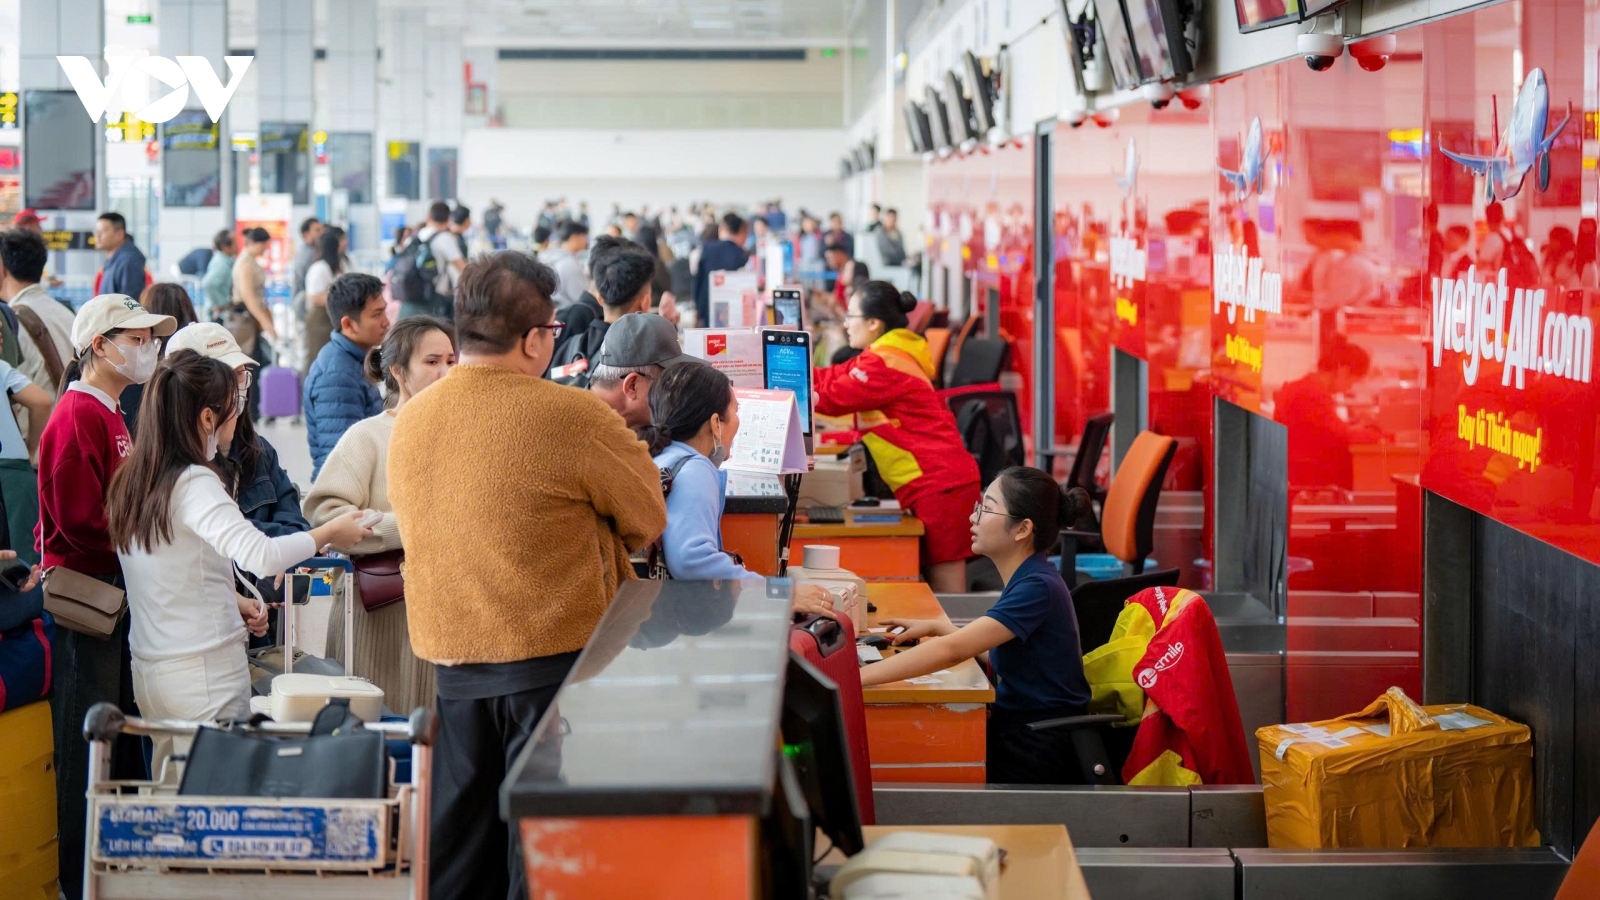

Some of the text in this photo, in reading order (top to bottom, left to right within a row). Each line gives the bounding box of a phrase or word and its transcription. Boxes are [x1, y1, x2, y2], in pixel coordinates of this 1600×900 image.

[1458, 404, 1476, 451] Bay
[1486, 411, 1512, 455] Thích
[1512, 427, 1542, 473] ngay!
[1154, 641, 1184, 669] smile
[187, 809, 239, 831] 20.000
